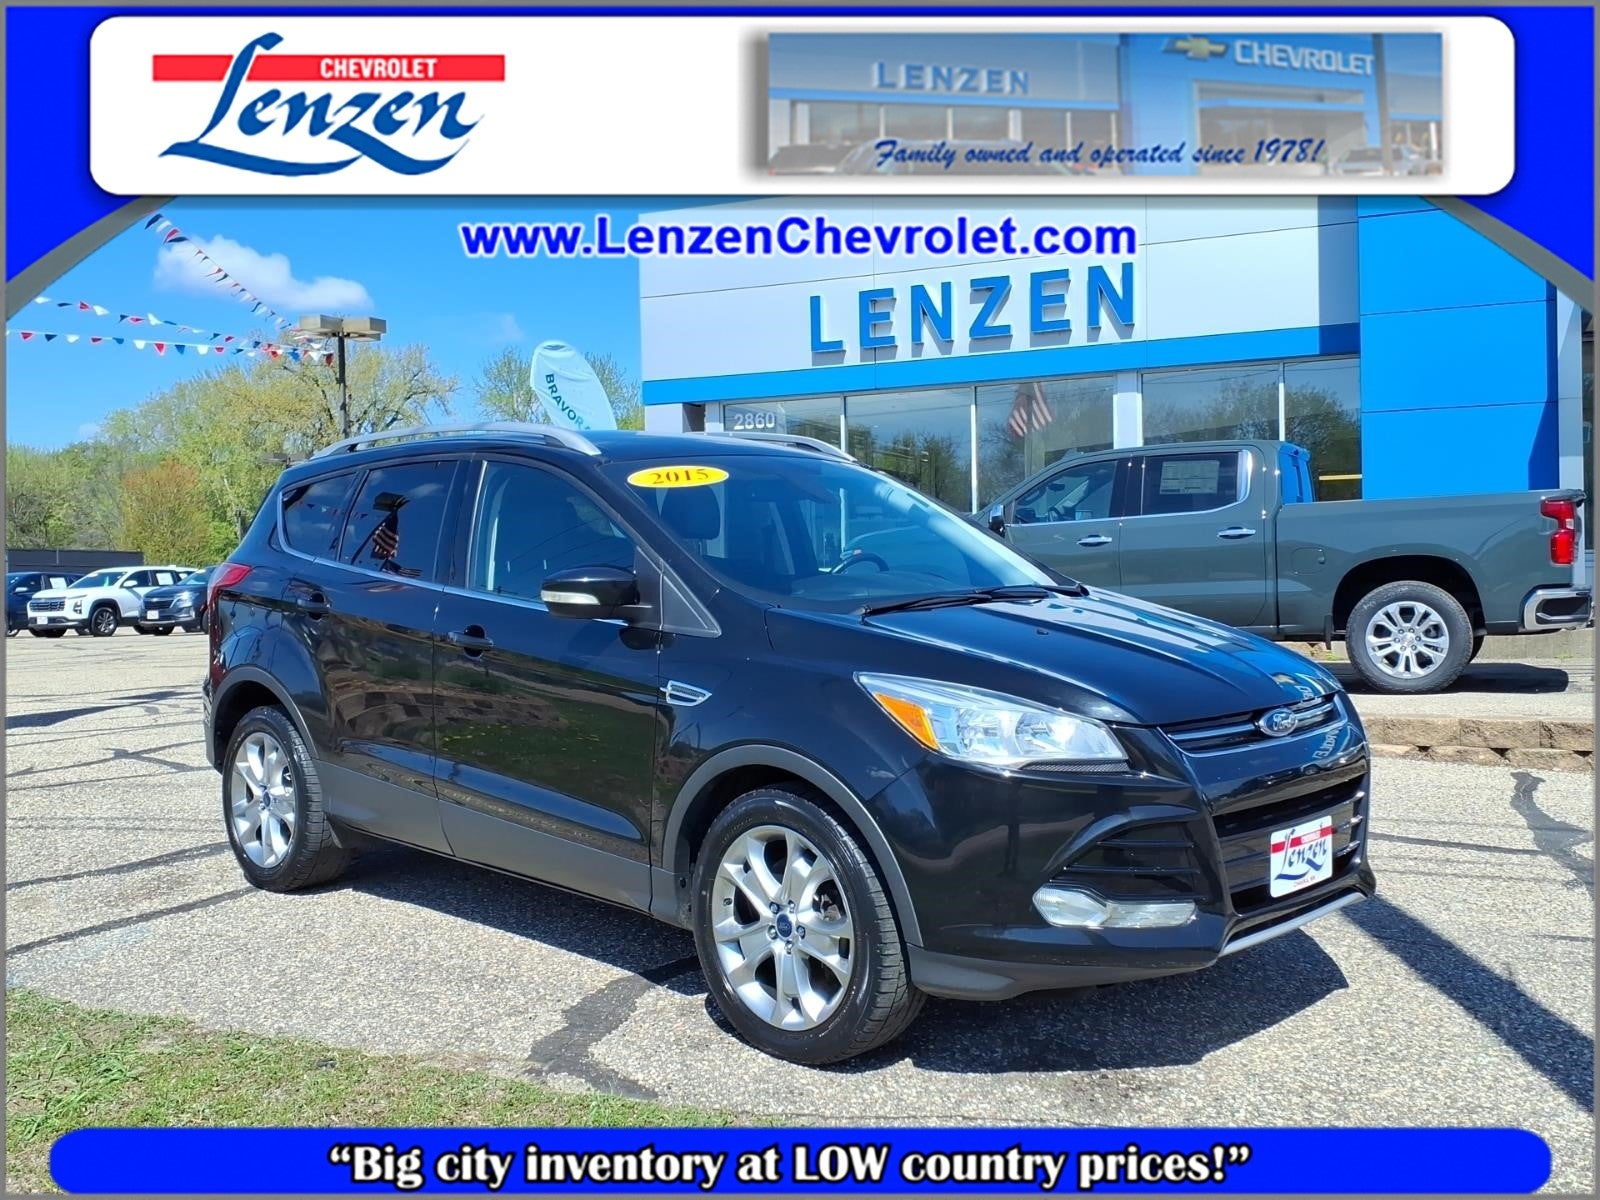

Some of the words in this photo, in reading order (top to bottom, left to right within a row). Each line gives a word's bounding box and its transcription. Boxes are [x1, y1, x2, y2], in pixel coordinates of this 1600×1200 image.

[809, 261, 1135, 355] LENZEN
[733, 411, 776, 431] 2860
[651, 467, 710, 486] 2015
